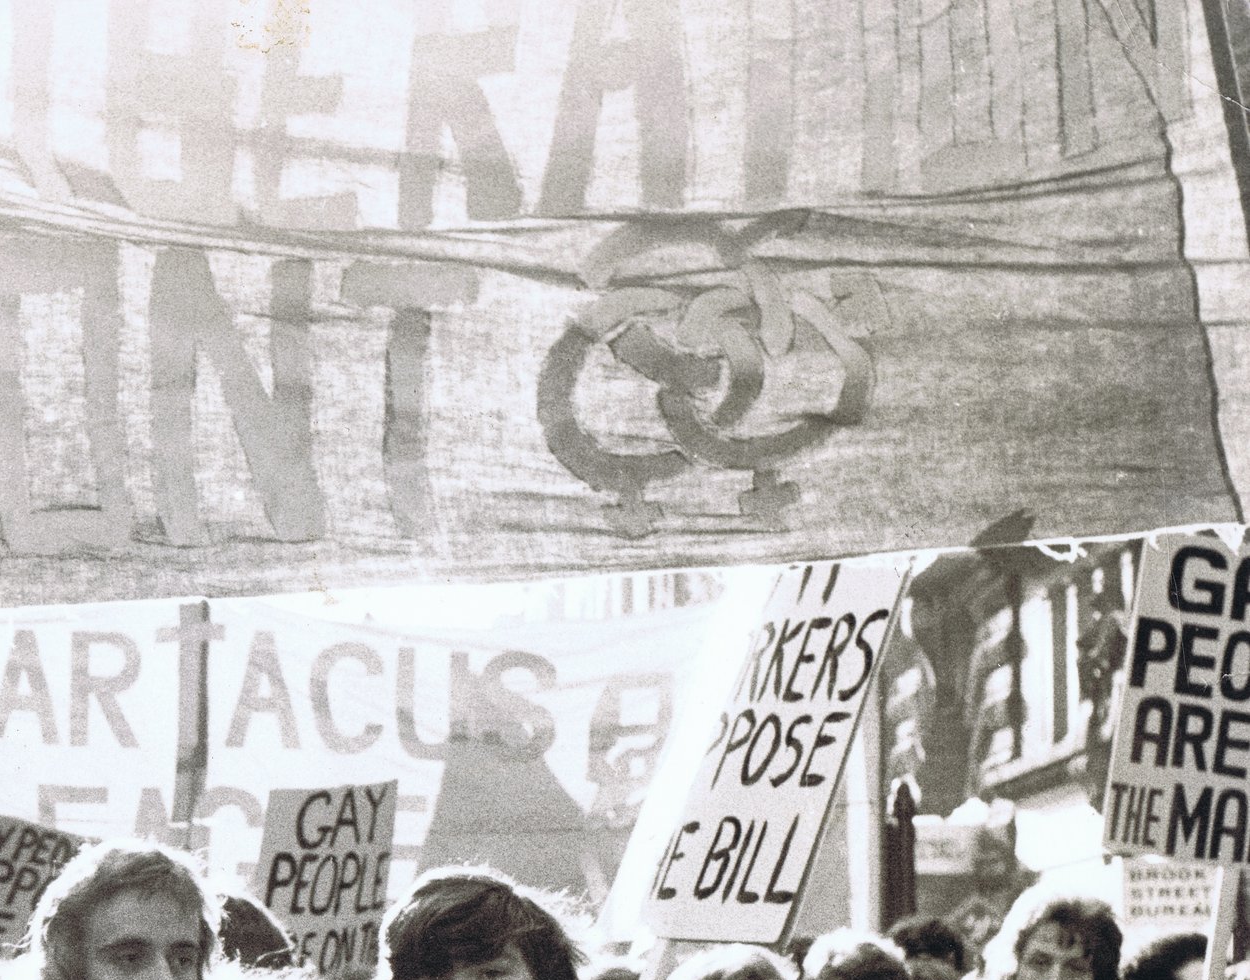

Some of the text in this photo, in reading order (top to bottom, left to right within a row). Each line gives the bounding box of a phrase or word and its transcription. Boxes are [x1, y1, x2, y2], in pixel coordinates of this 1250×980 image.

[733, 609, 889, 702] RKERS
[1129, 616, 1250, 701] PEO
[706, 708, 852, 790] PPOSE
[1130, 696, 1250, 778] ARE
[295, 783, 389, 850] GAY
[1108, 782, 1250, 863] THE MA
[265, 850, 392, 916] PEOPLE
[693, 812, 801, 905] BILL
